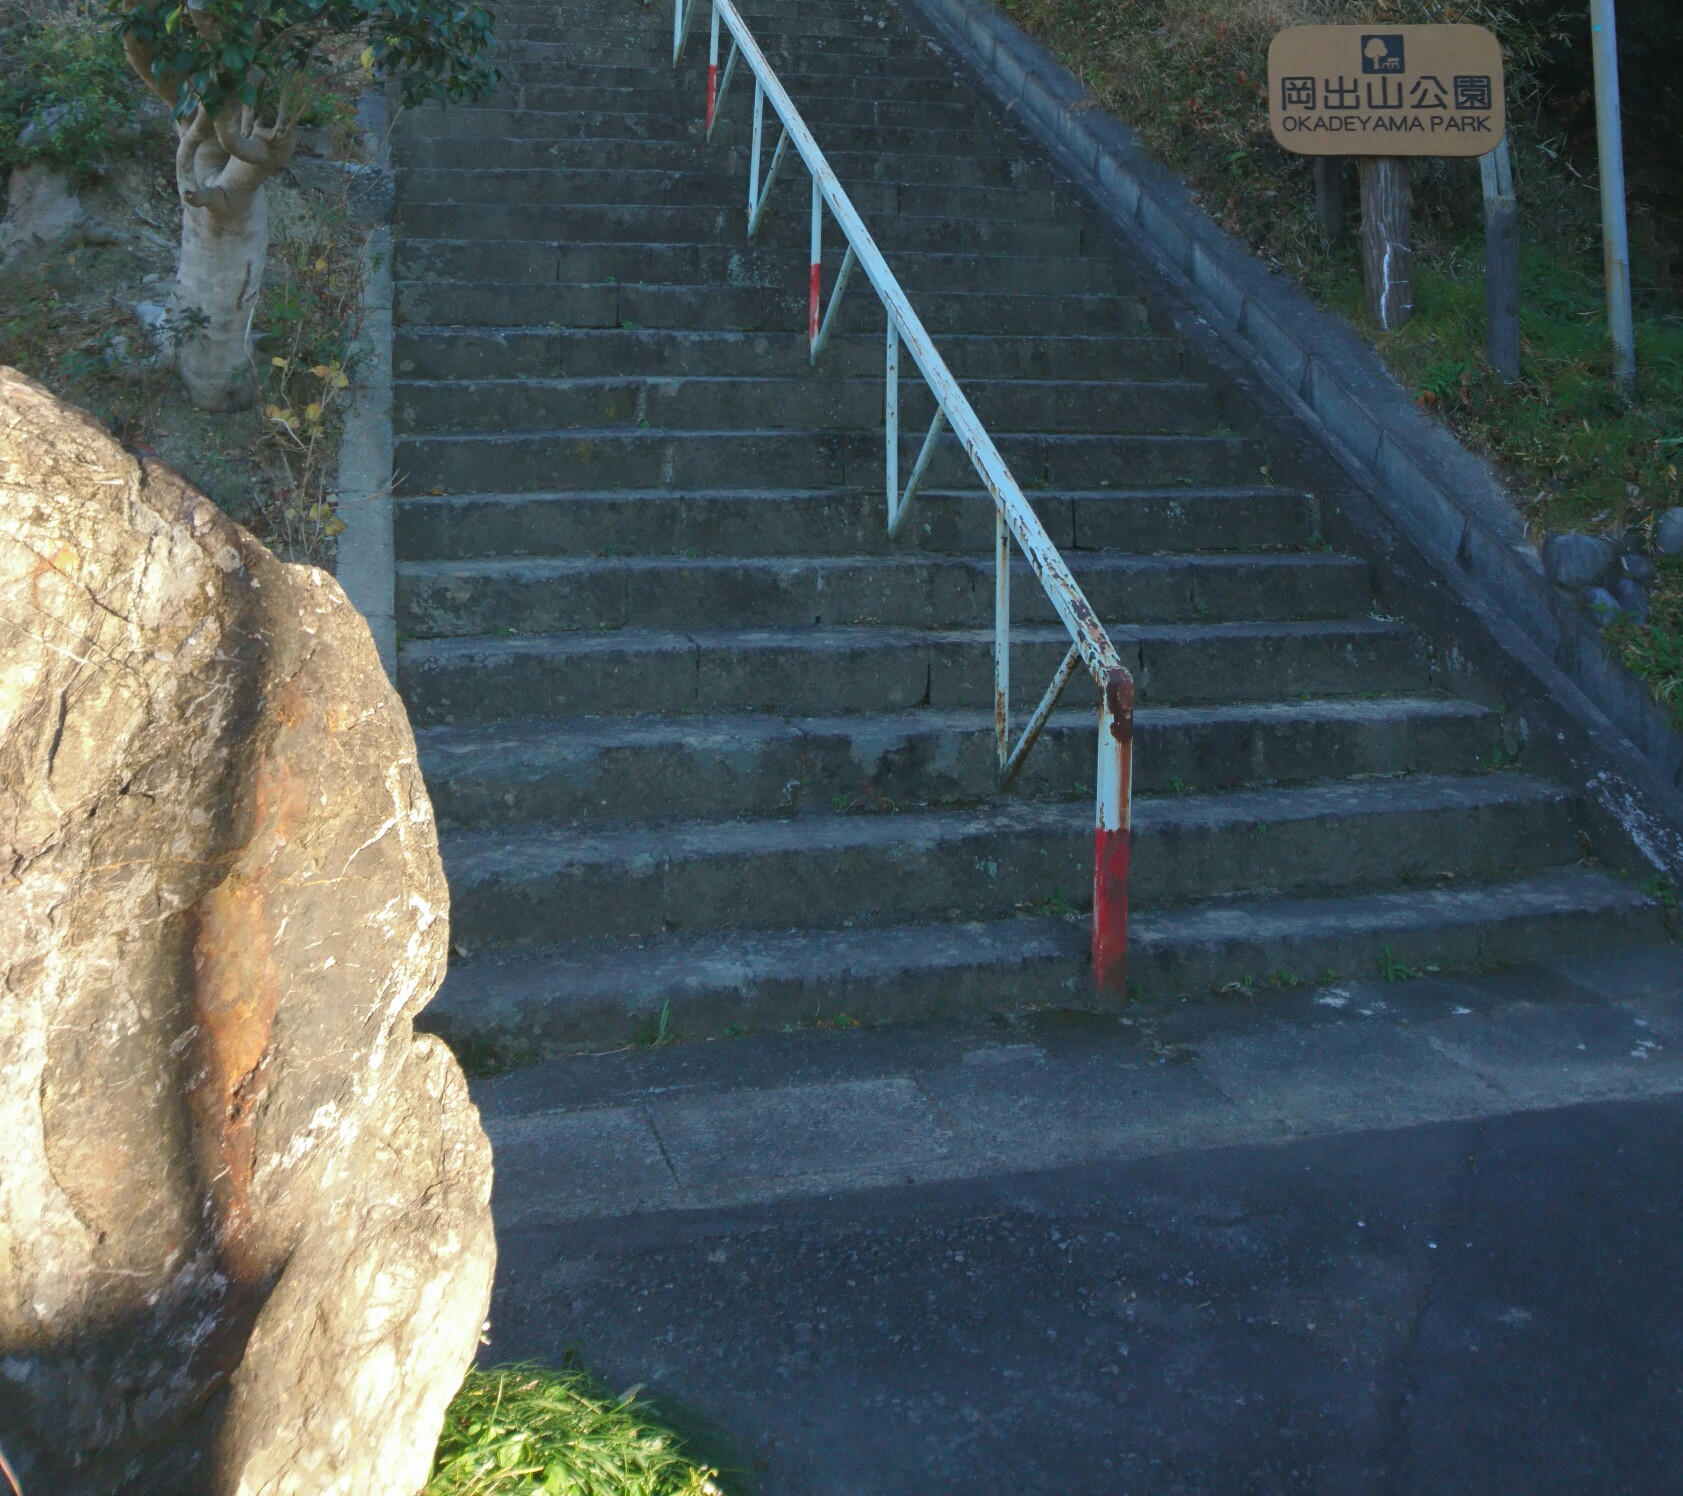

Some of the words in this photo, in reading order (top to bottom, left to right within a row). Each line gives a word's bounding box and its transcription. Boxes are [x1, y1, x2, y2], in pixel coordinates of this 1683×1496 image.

[1281, 75, 1492, 111] 岡出山公園
[1282, 115, 1425, 132] OKADEYAMA
[1430, 115, 1492, 132] PARK
